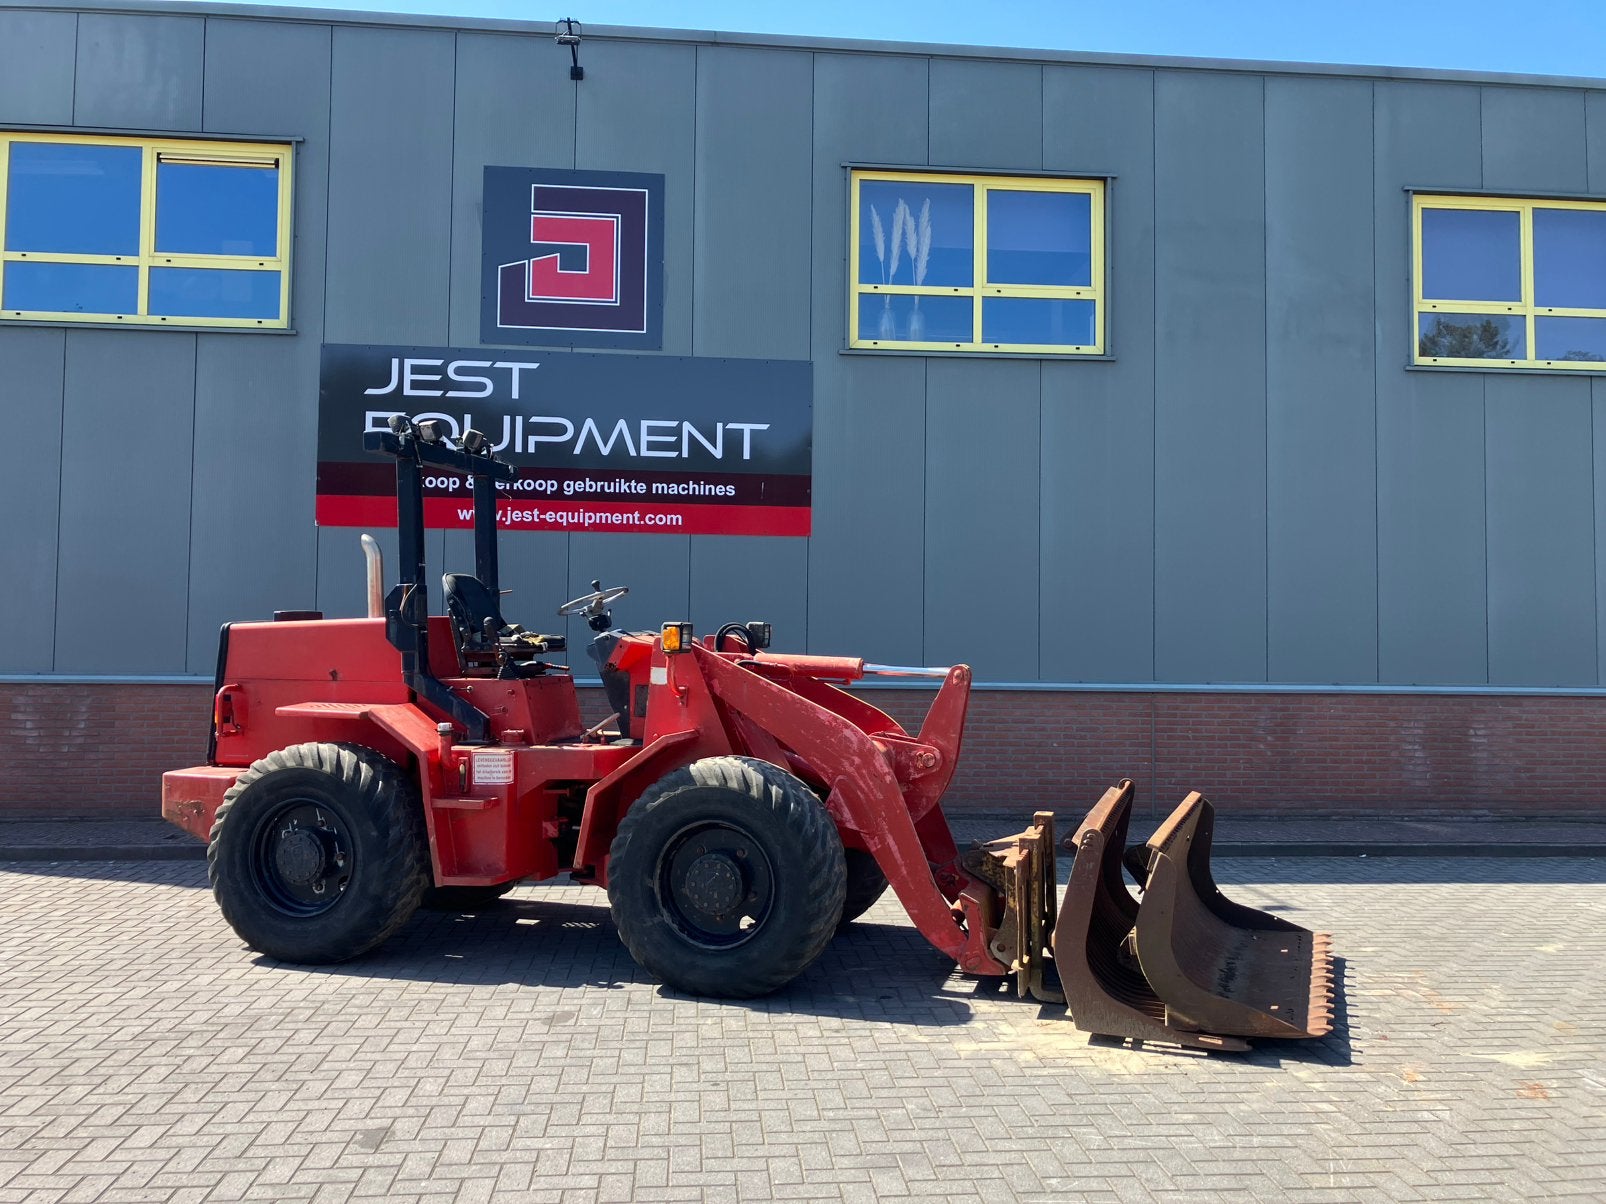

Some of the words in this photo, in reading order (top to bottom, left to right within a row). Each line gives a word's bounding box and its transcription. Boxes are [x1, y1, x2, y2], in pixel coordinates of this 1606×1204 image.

[363, 357, 540, 399] JEST
[563, 478, 647, 497] gebruikte
[651, 480, 736, 496] machines
